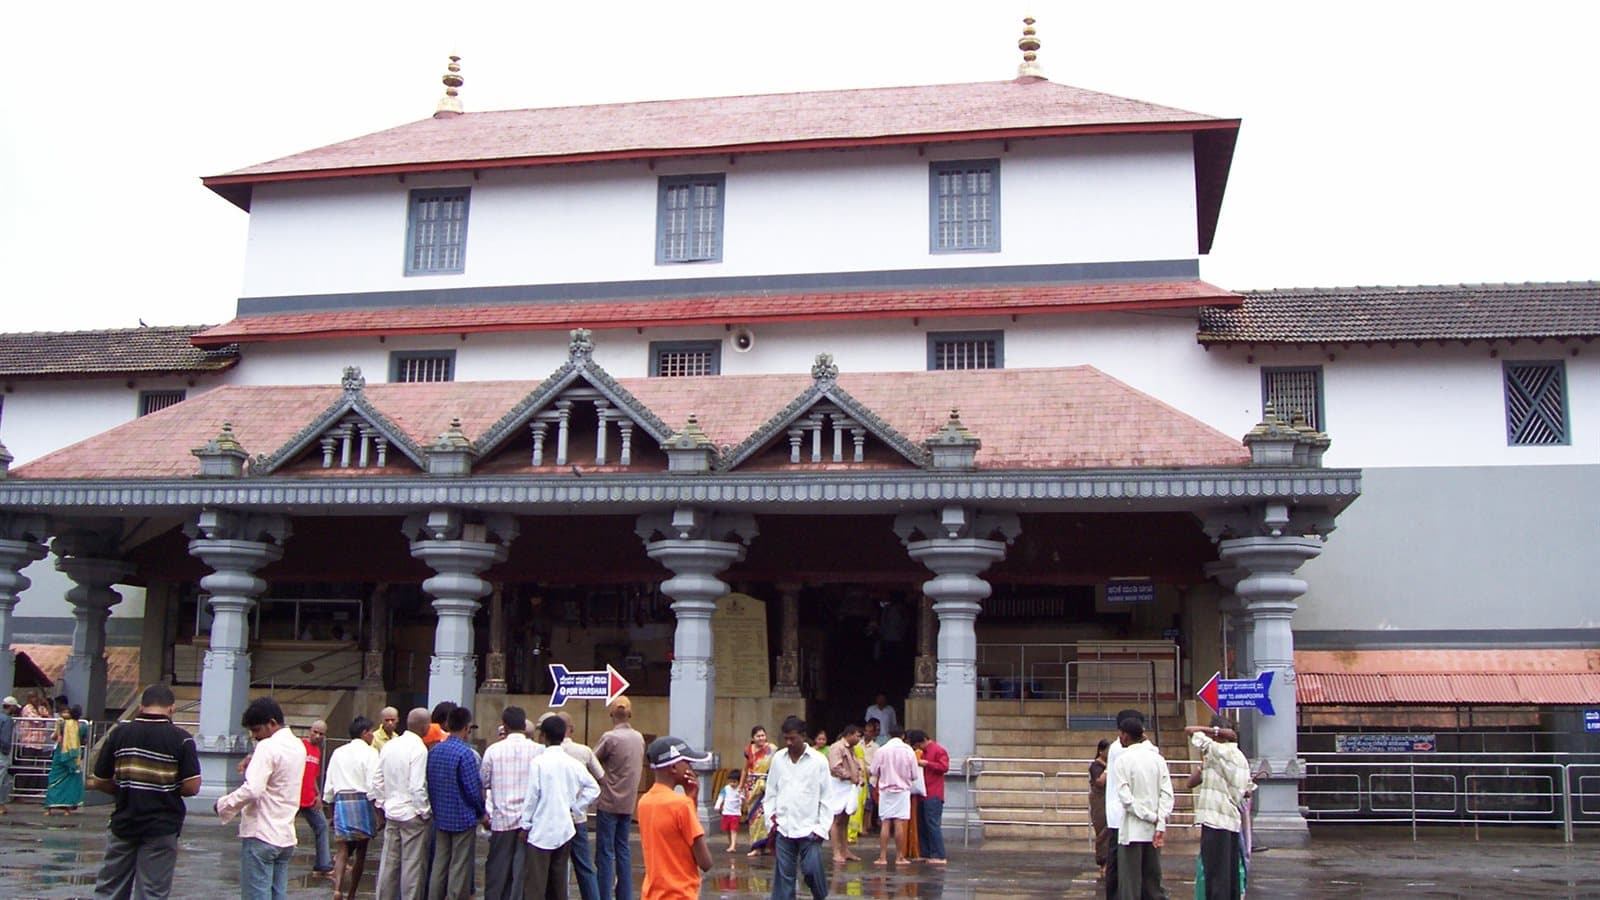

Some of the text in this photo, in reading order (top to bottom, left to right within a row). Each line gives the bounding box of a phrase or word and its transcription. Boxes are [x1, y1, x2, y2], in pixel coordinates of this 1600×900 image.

[560, 686, 607, 696] Q FOR DARSHAN
